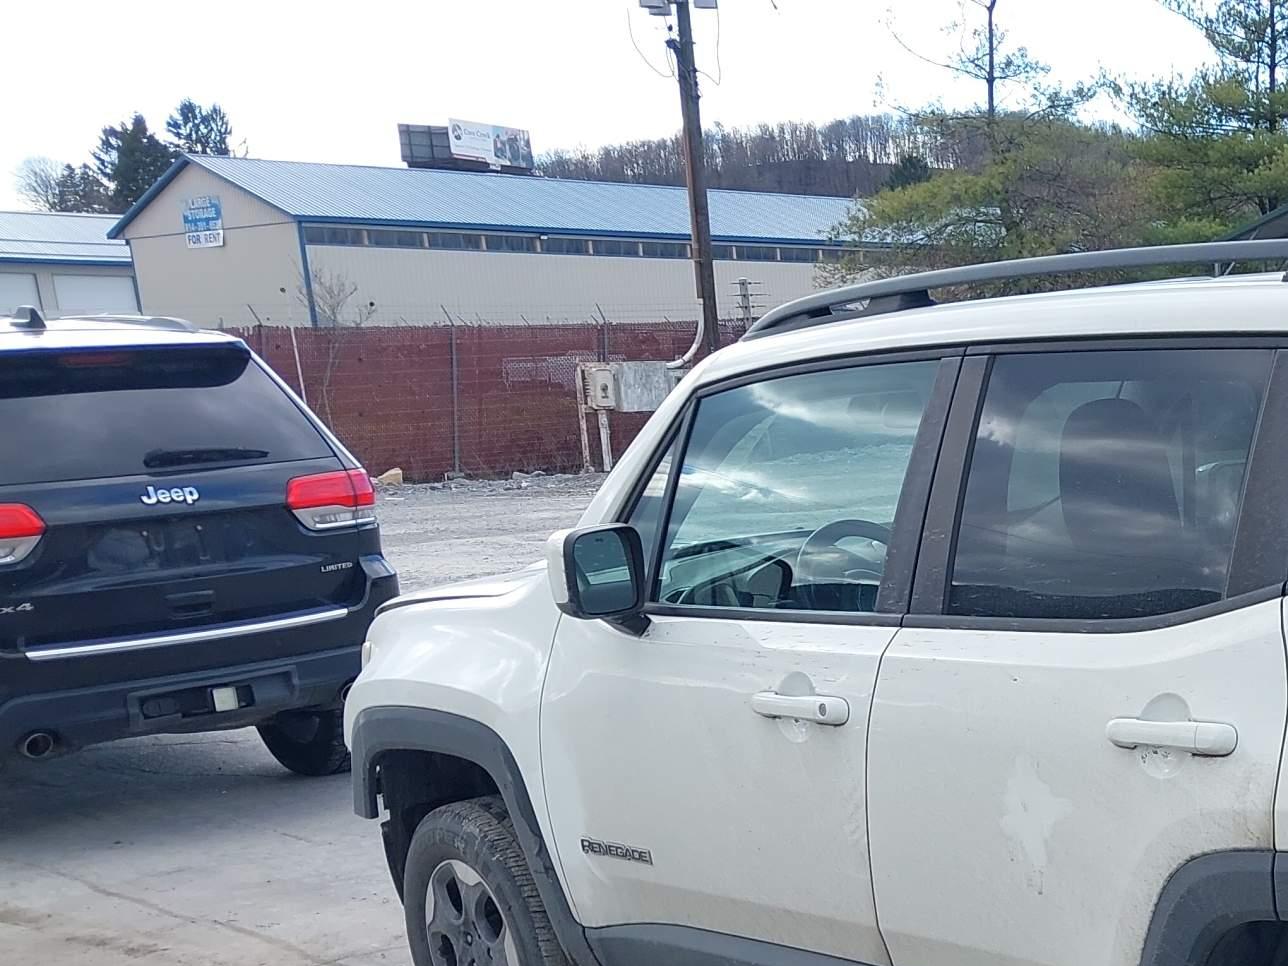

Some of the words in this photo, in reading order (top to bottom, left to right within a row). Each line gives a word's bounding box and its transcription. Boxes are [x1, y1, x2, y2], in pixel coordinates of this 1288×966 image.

[187, 196, 212, 208] LARGE
[187, 207, 217, 220] STORAGE
[188, 234, 201, 245] FOR
[204, 232, 221, 244] RENT
[140, 485, 199, 506] Jeep
[321, 562, 353, 572] LIMITED
[581, 837, 653, 866] RENEGADE
